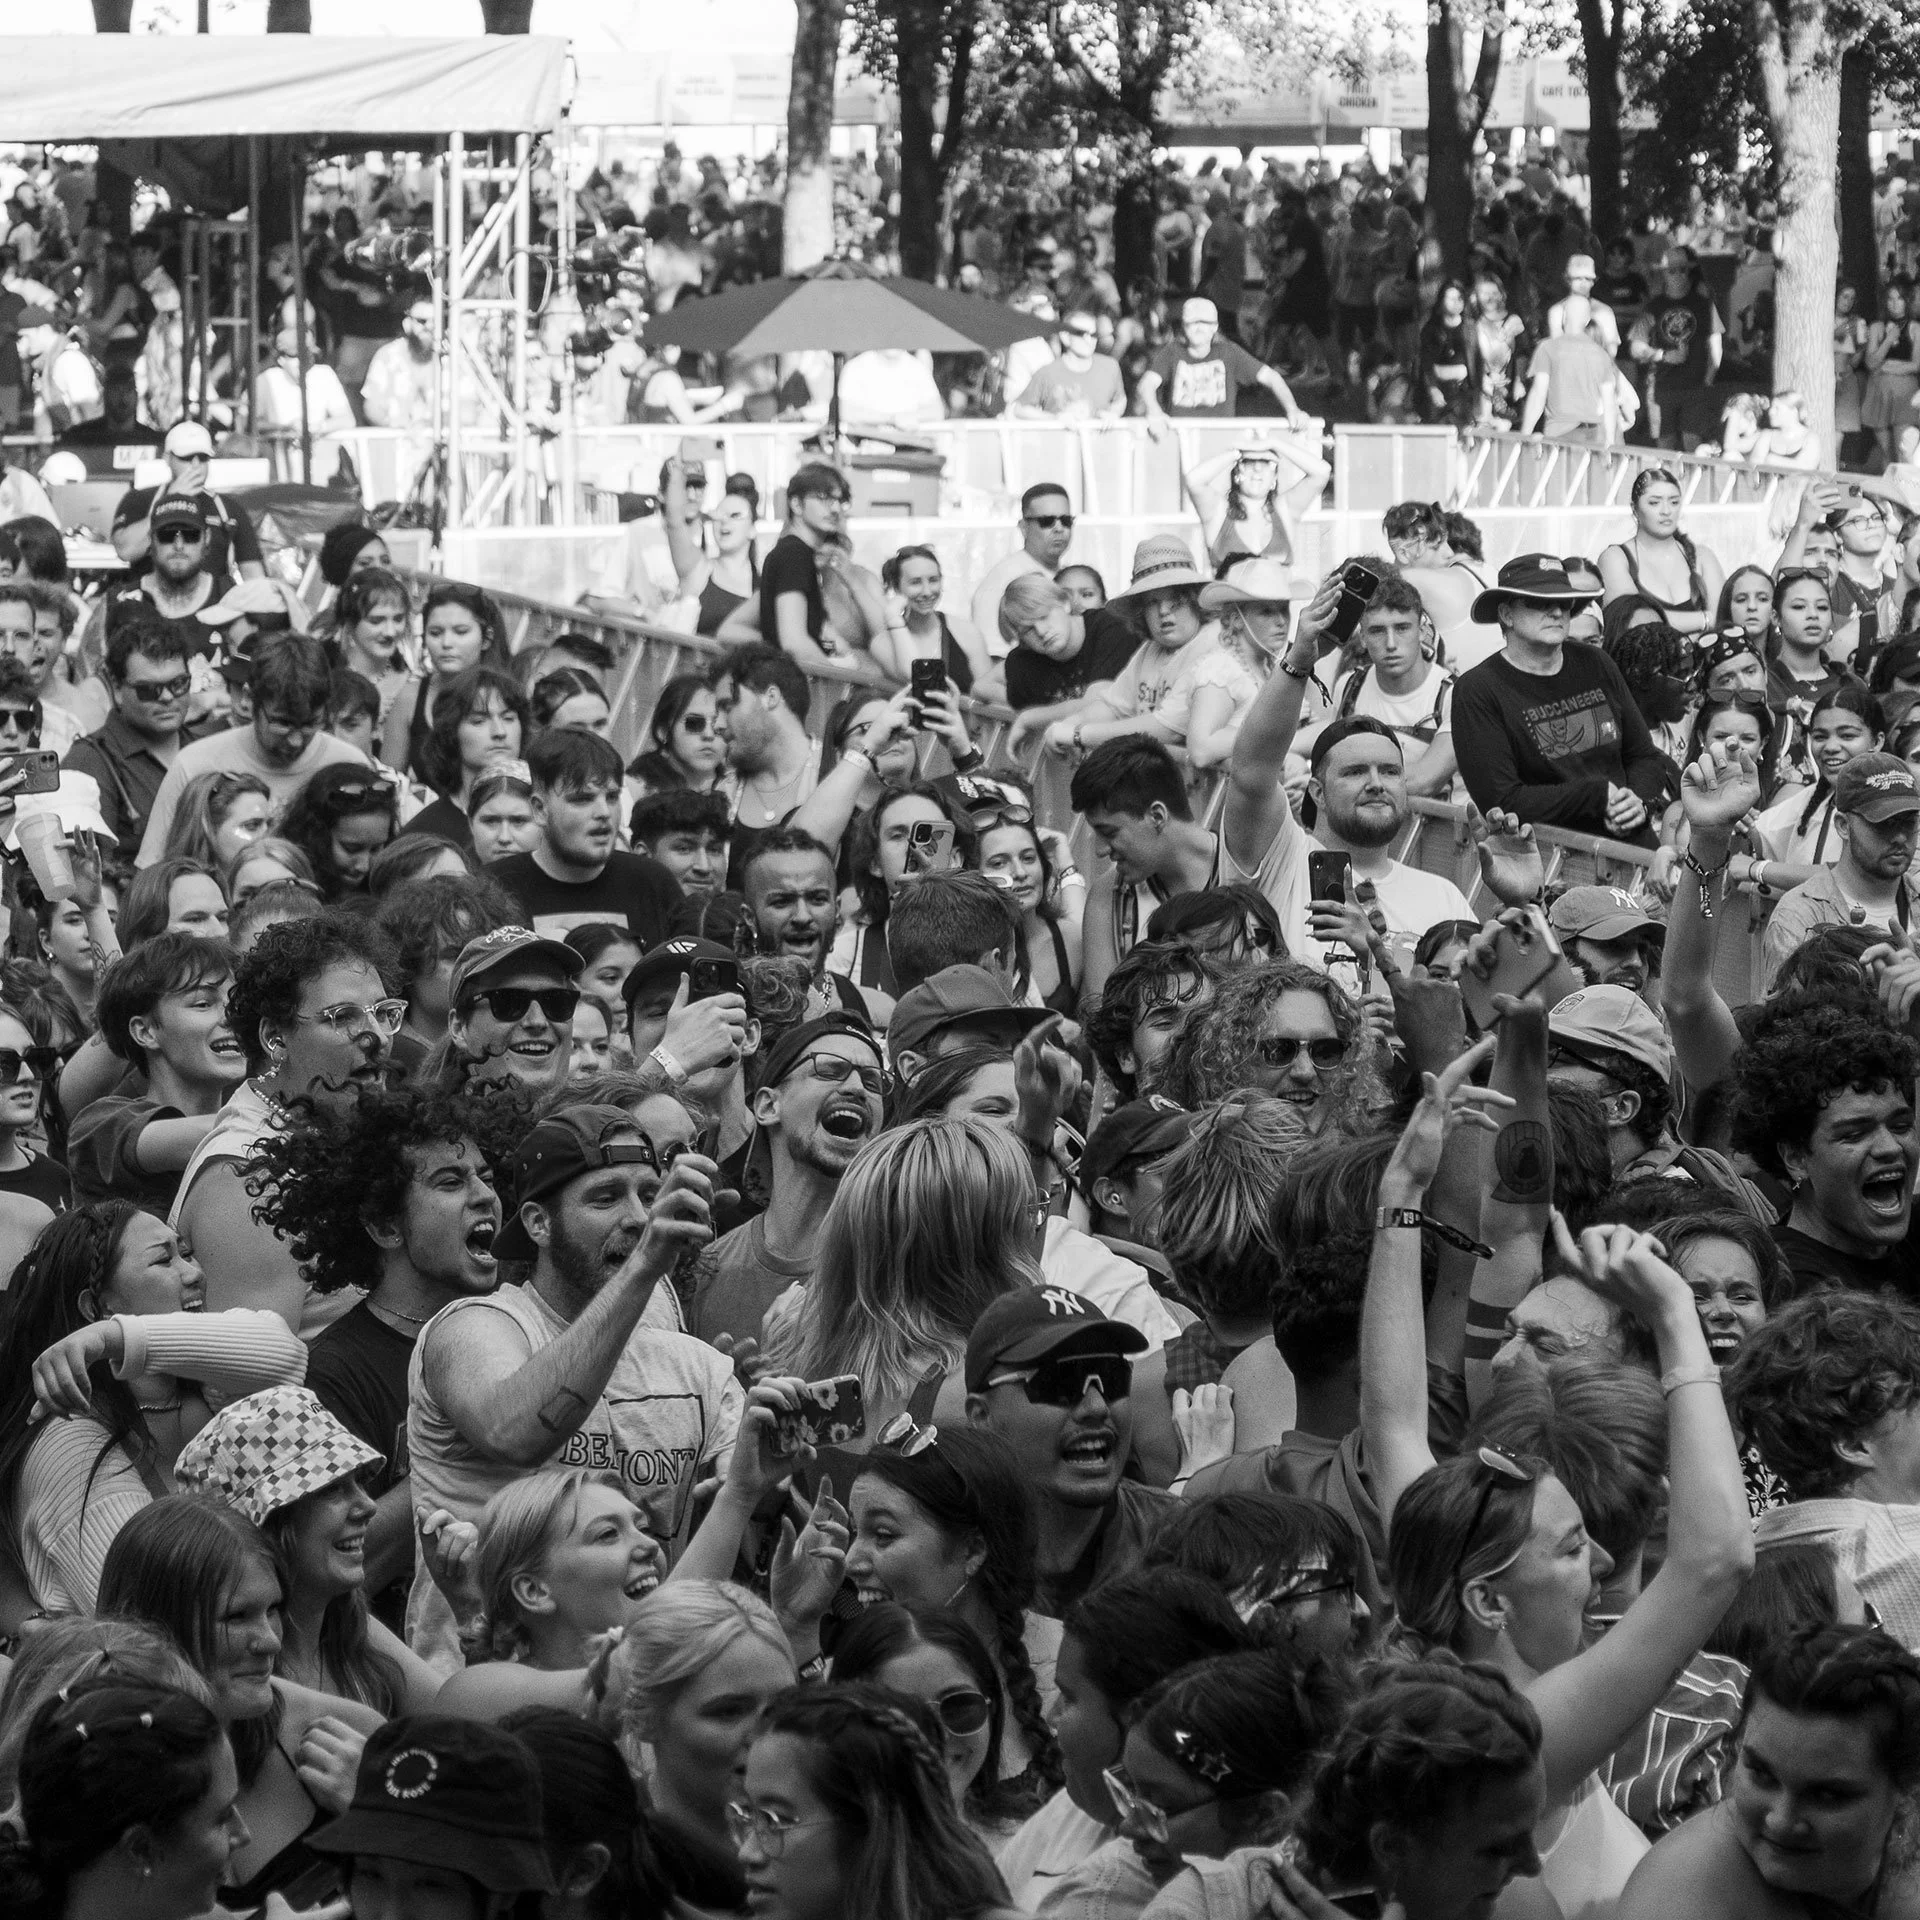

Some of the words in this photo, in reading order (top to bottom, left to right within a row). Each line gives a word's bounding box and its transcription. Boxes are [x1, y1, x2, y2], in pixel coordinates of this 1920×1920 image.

[1339, 96, 1379, 108] CHICKEN
[1527, 688, 1607, 721] BUCCANEERS
[1609, 888, 1640, 910] NY
[1041, 1288, 1085, 1316] NY
